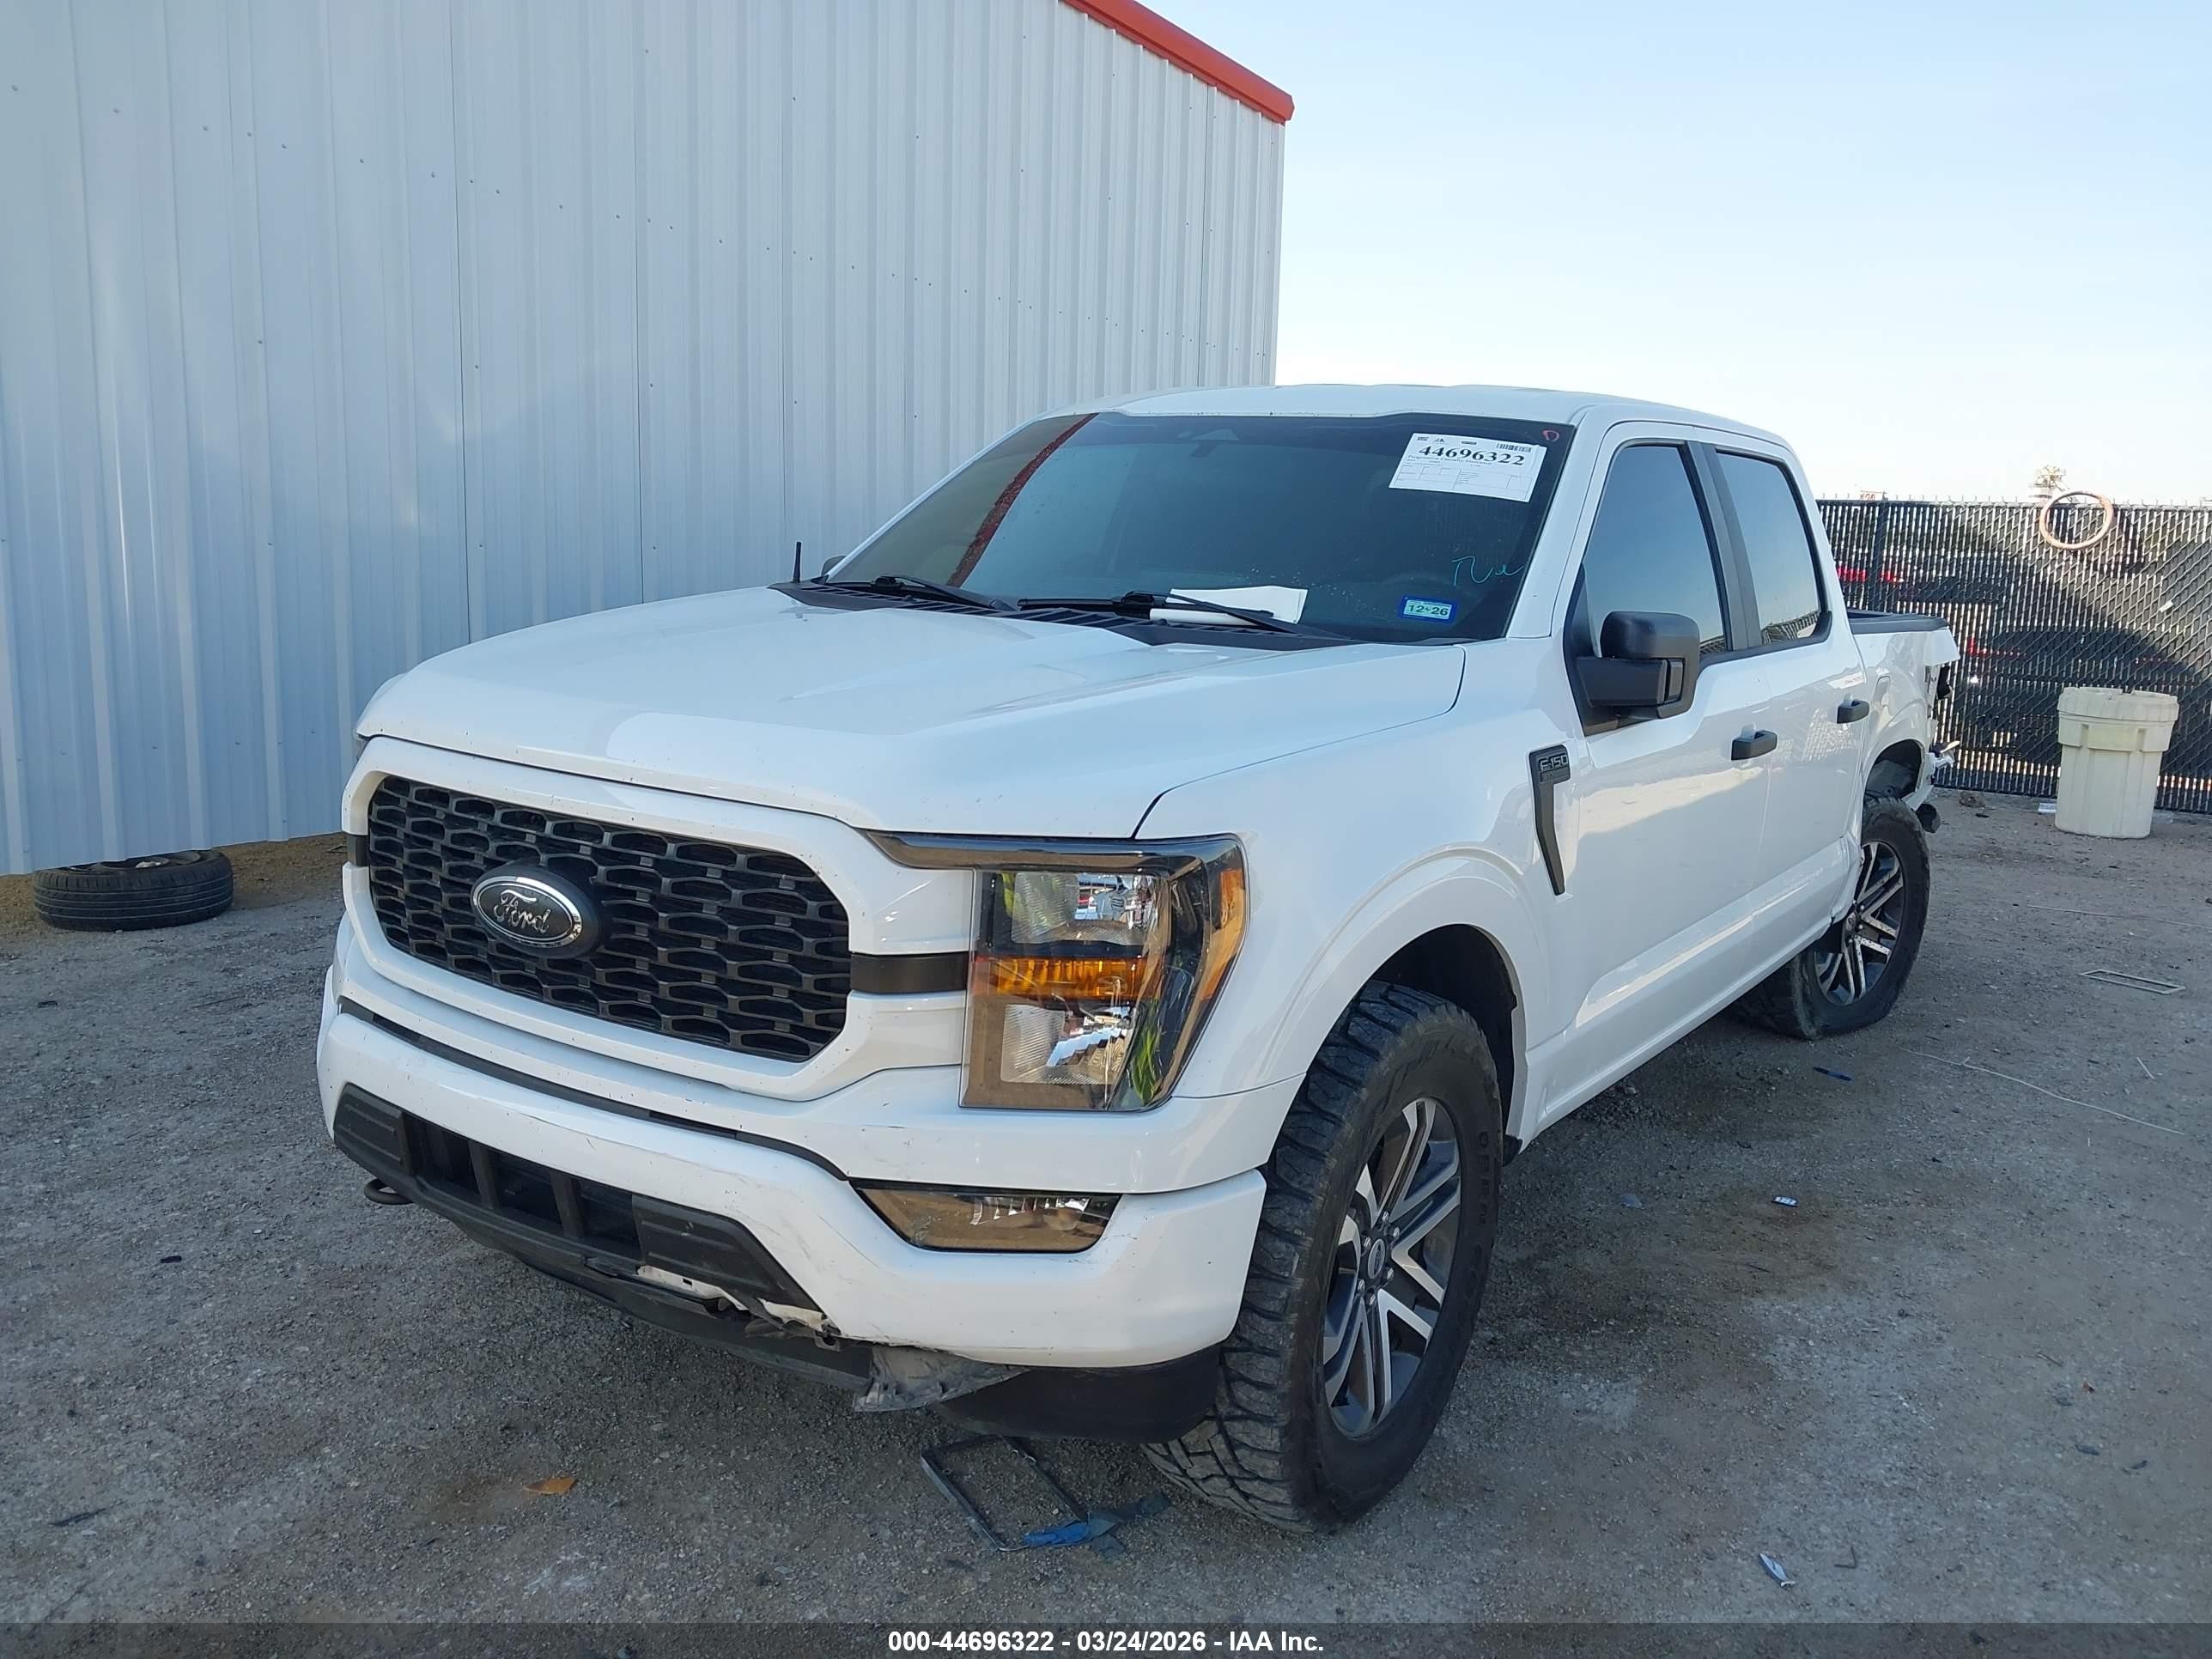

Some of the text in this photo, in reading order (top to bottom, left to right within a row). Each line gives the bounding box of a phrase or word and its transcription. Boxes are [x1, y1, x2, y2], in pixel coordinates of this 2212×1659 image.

[1419, 446, 1525, 466] 44696322
[1540, 754, 1568, 771] F-150
[493, 889, 551, 934] Ford
